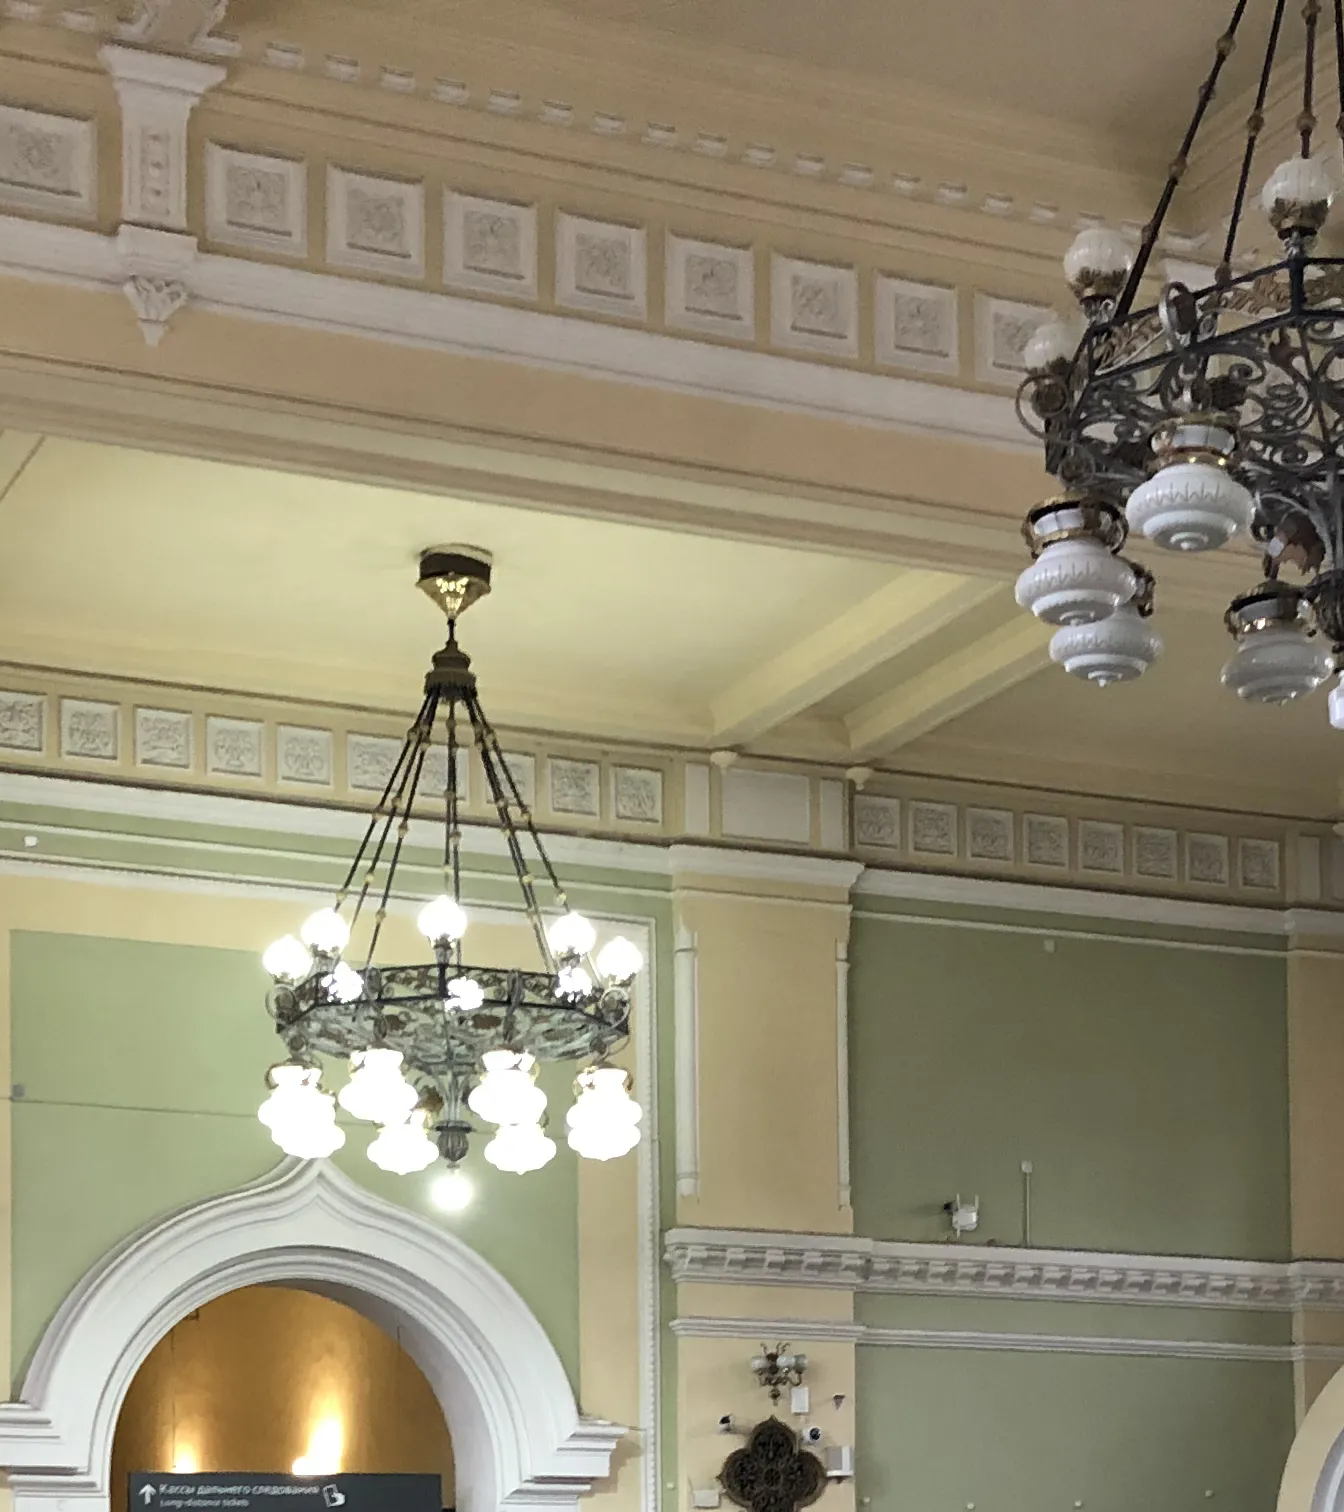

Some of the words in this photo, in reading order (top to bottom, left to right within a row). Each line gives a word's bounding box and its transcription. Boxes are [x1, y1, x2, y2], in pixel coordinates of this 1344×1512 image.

[159, 1484, 195, 1495] Кассы
[197, 1484, 250, 1496] дальнего
[251, 1484, 321, 1496] следования
